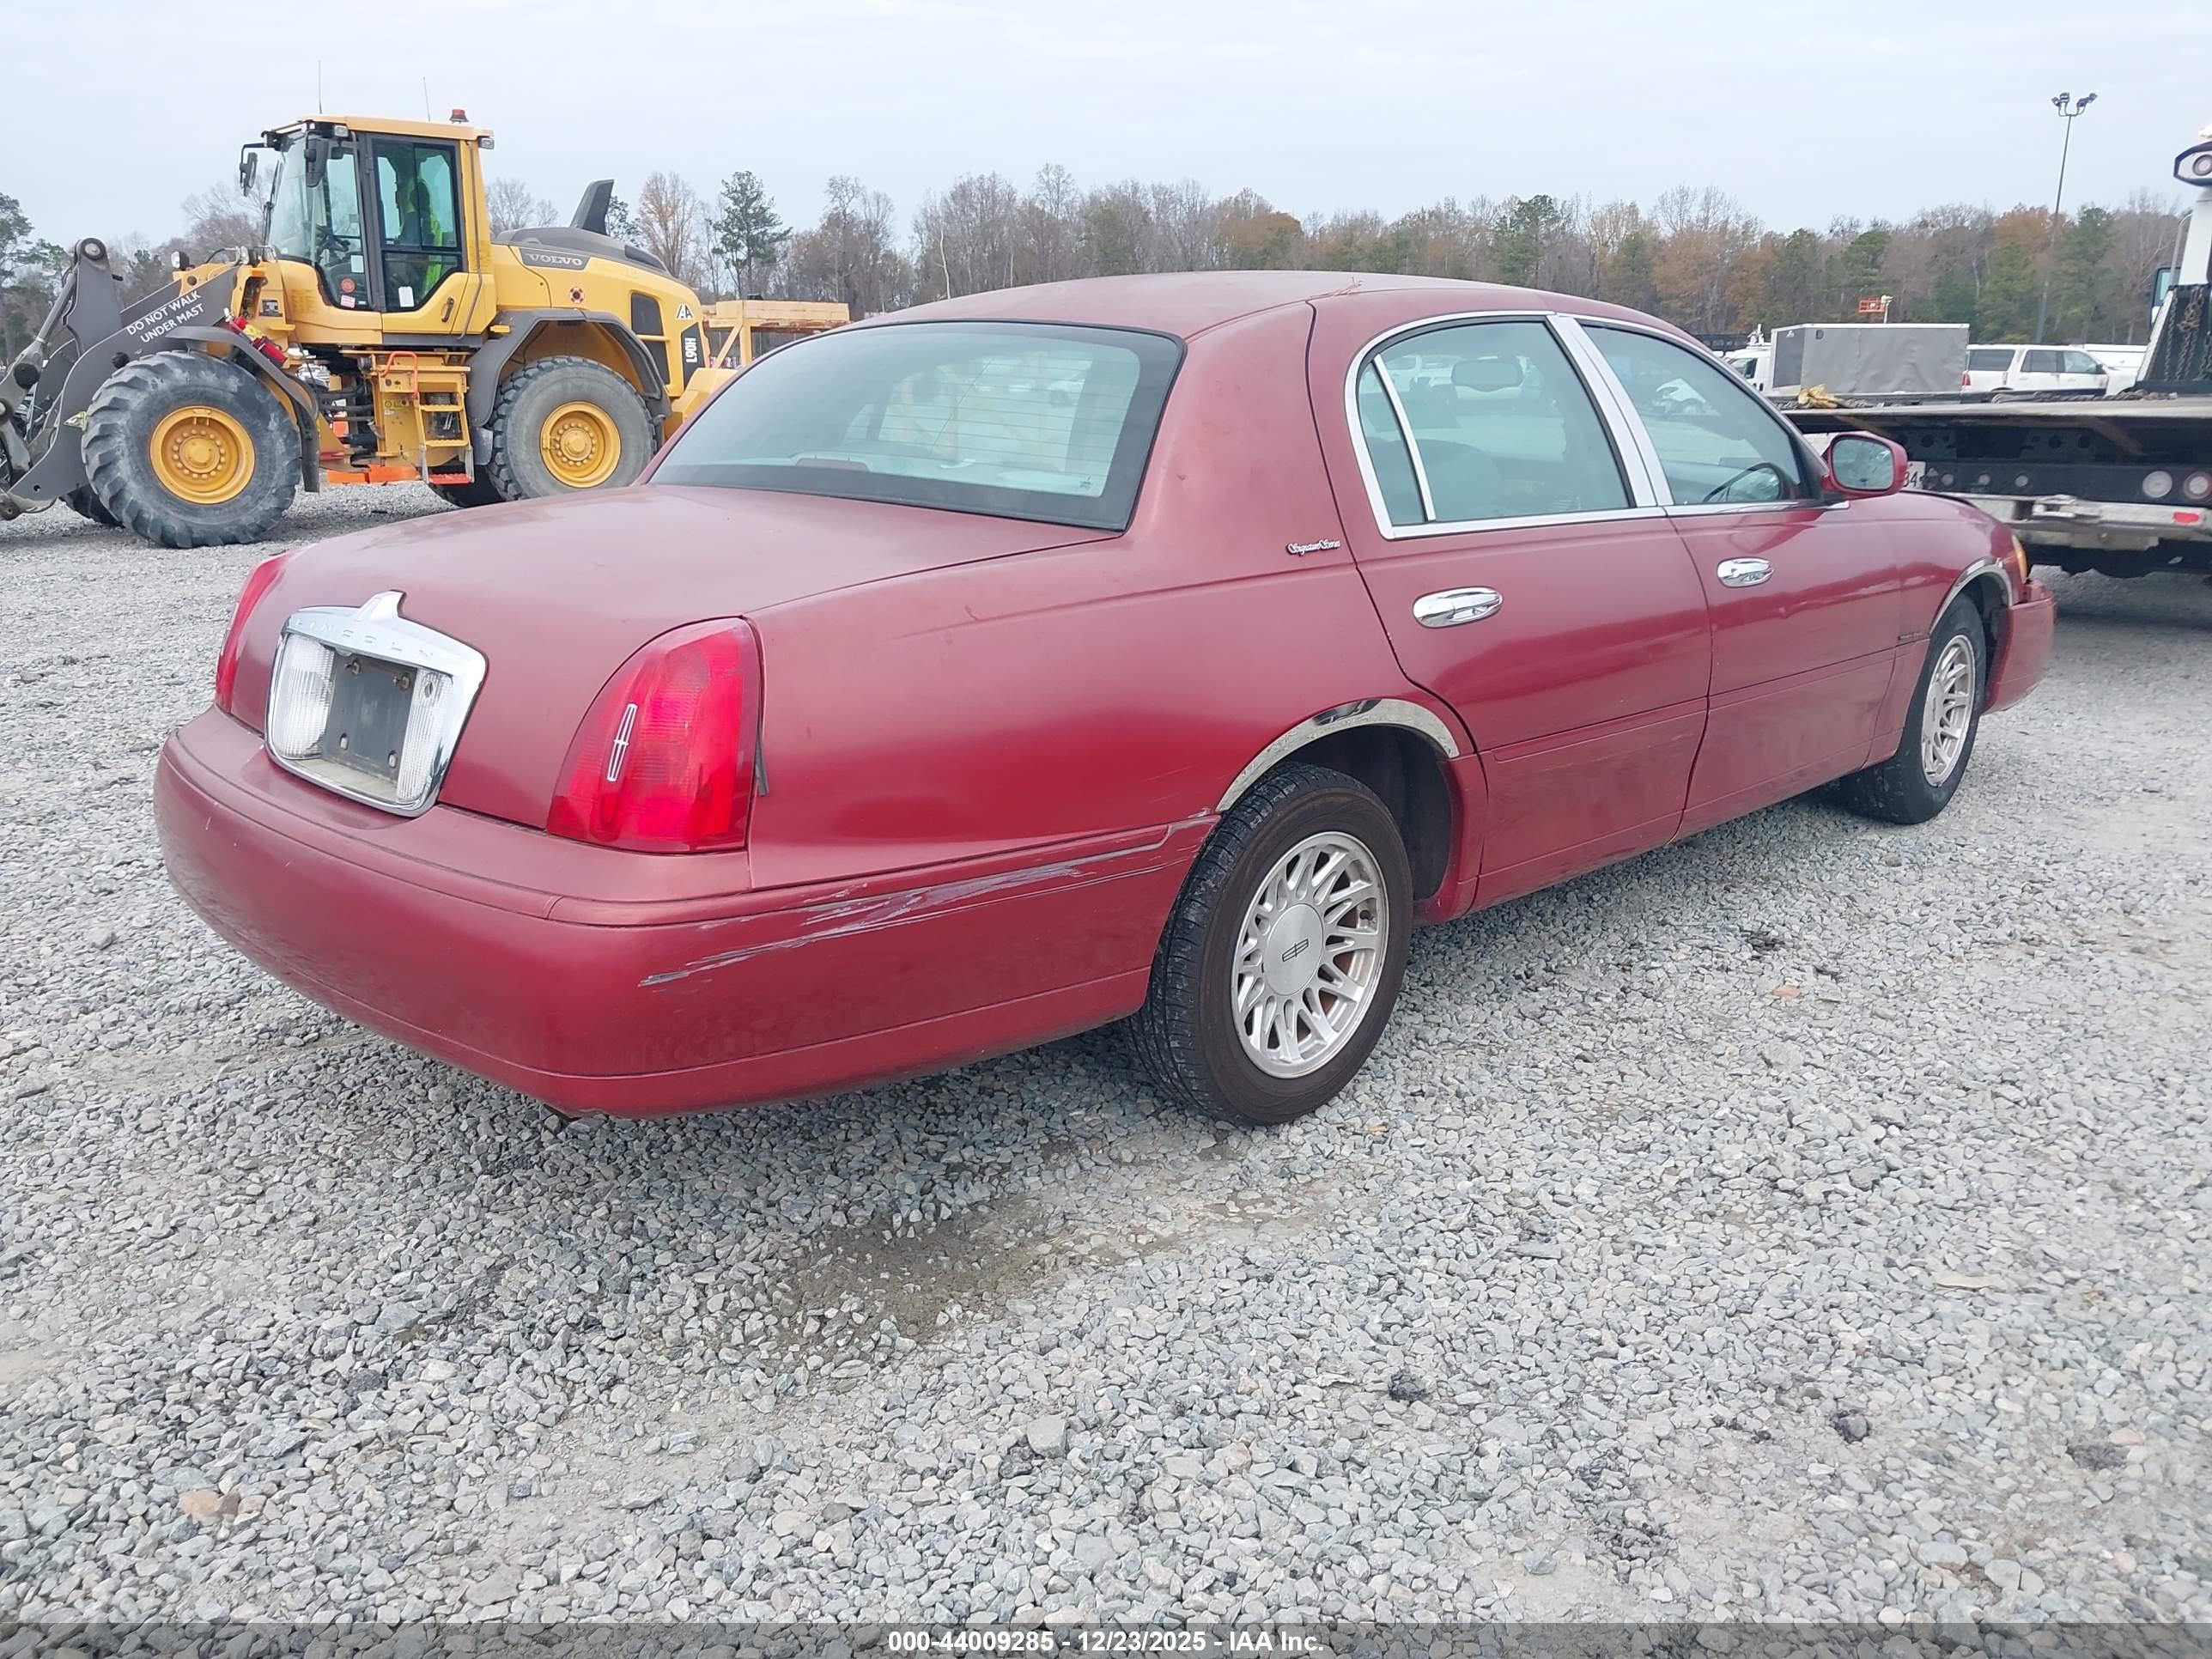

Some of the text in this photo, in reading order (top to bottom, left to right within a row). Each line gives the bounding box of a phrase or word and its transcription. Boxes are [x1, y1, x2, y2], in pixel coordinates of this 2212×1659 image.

[526, 253, 583, 266] VOLVO
[126, 290, 201, 336] DO NOT WALK
[140, 303, 204, 343] UNDER MAST
[684, 337, 698, 363] L90H
[295, 619, 434, 658] LINCOLN
